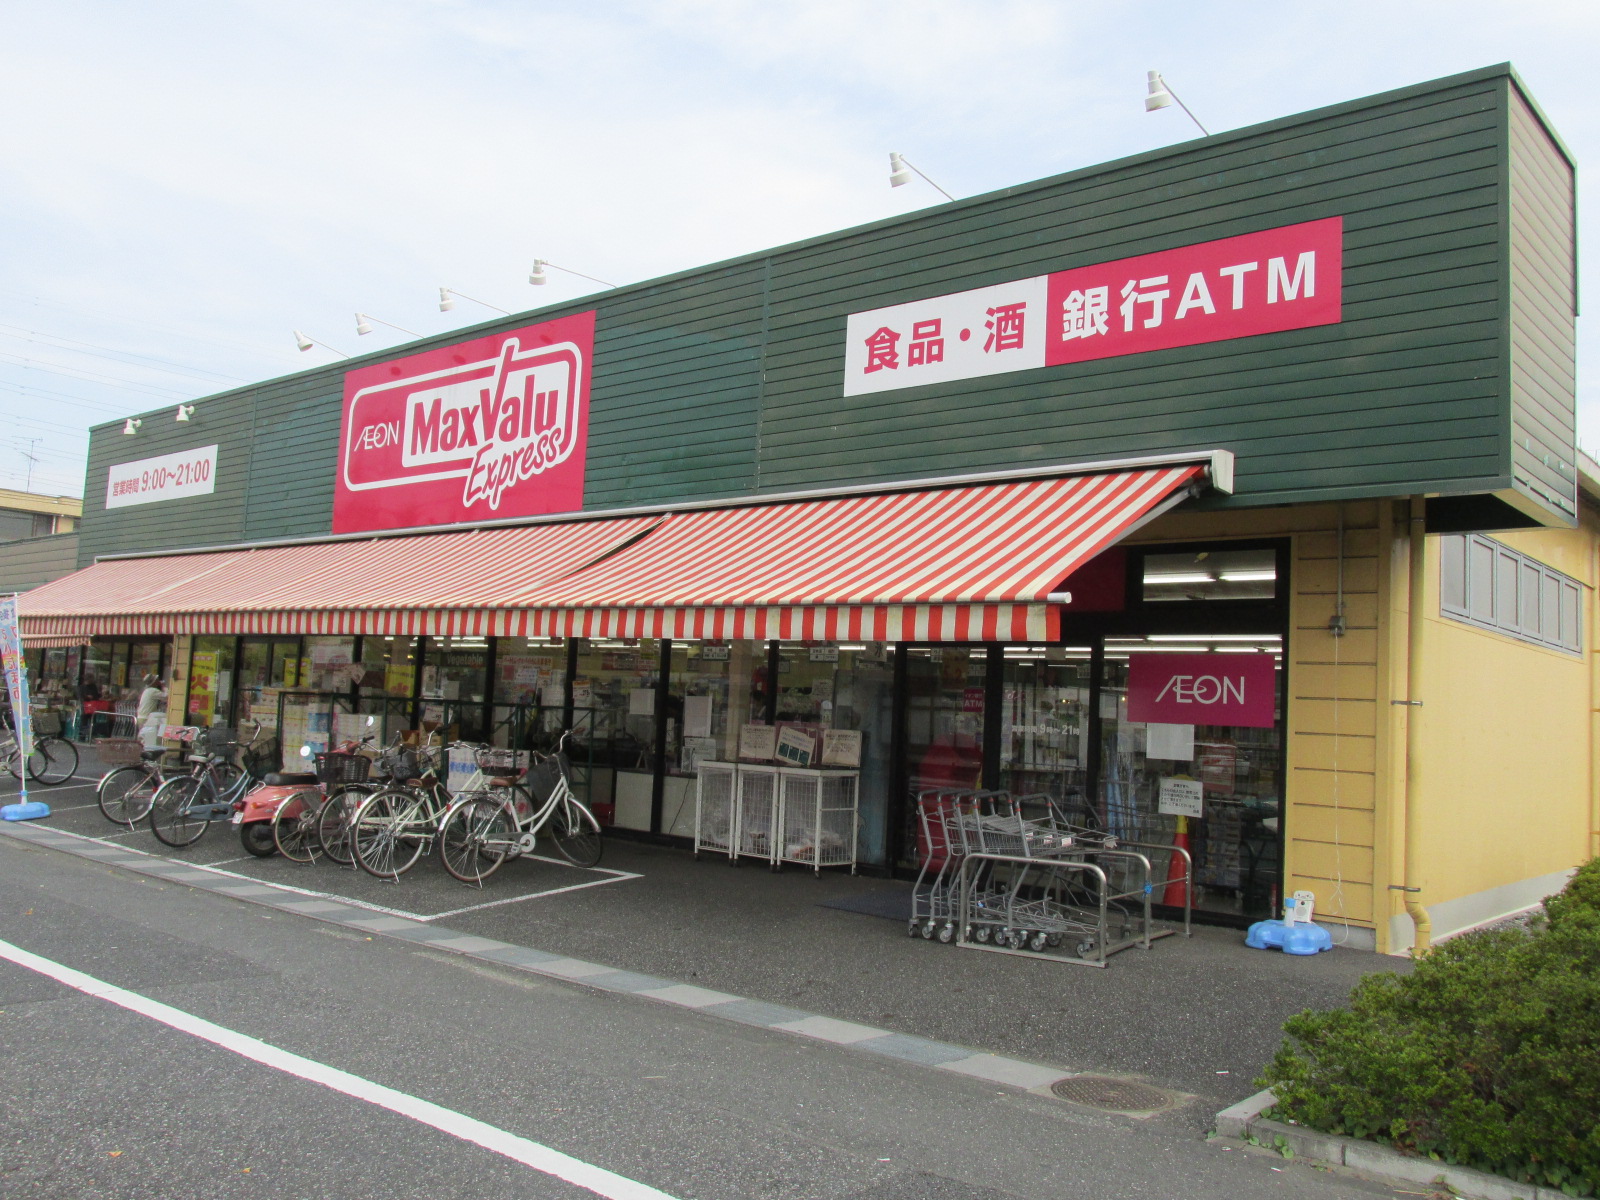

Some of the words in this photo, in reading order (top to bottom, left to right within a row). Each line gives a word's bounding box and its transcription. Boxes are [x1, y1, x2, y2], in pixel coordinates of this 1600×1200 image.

[862, 300, 1027, 375] 食品・酒
[1061, 250, 1316, 341] 銀行ATM
[410, 345, 559, 456] MaxValu
[465, 426, 562, 505] Express
[964, 699, 983, 707] ATM
